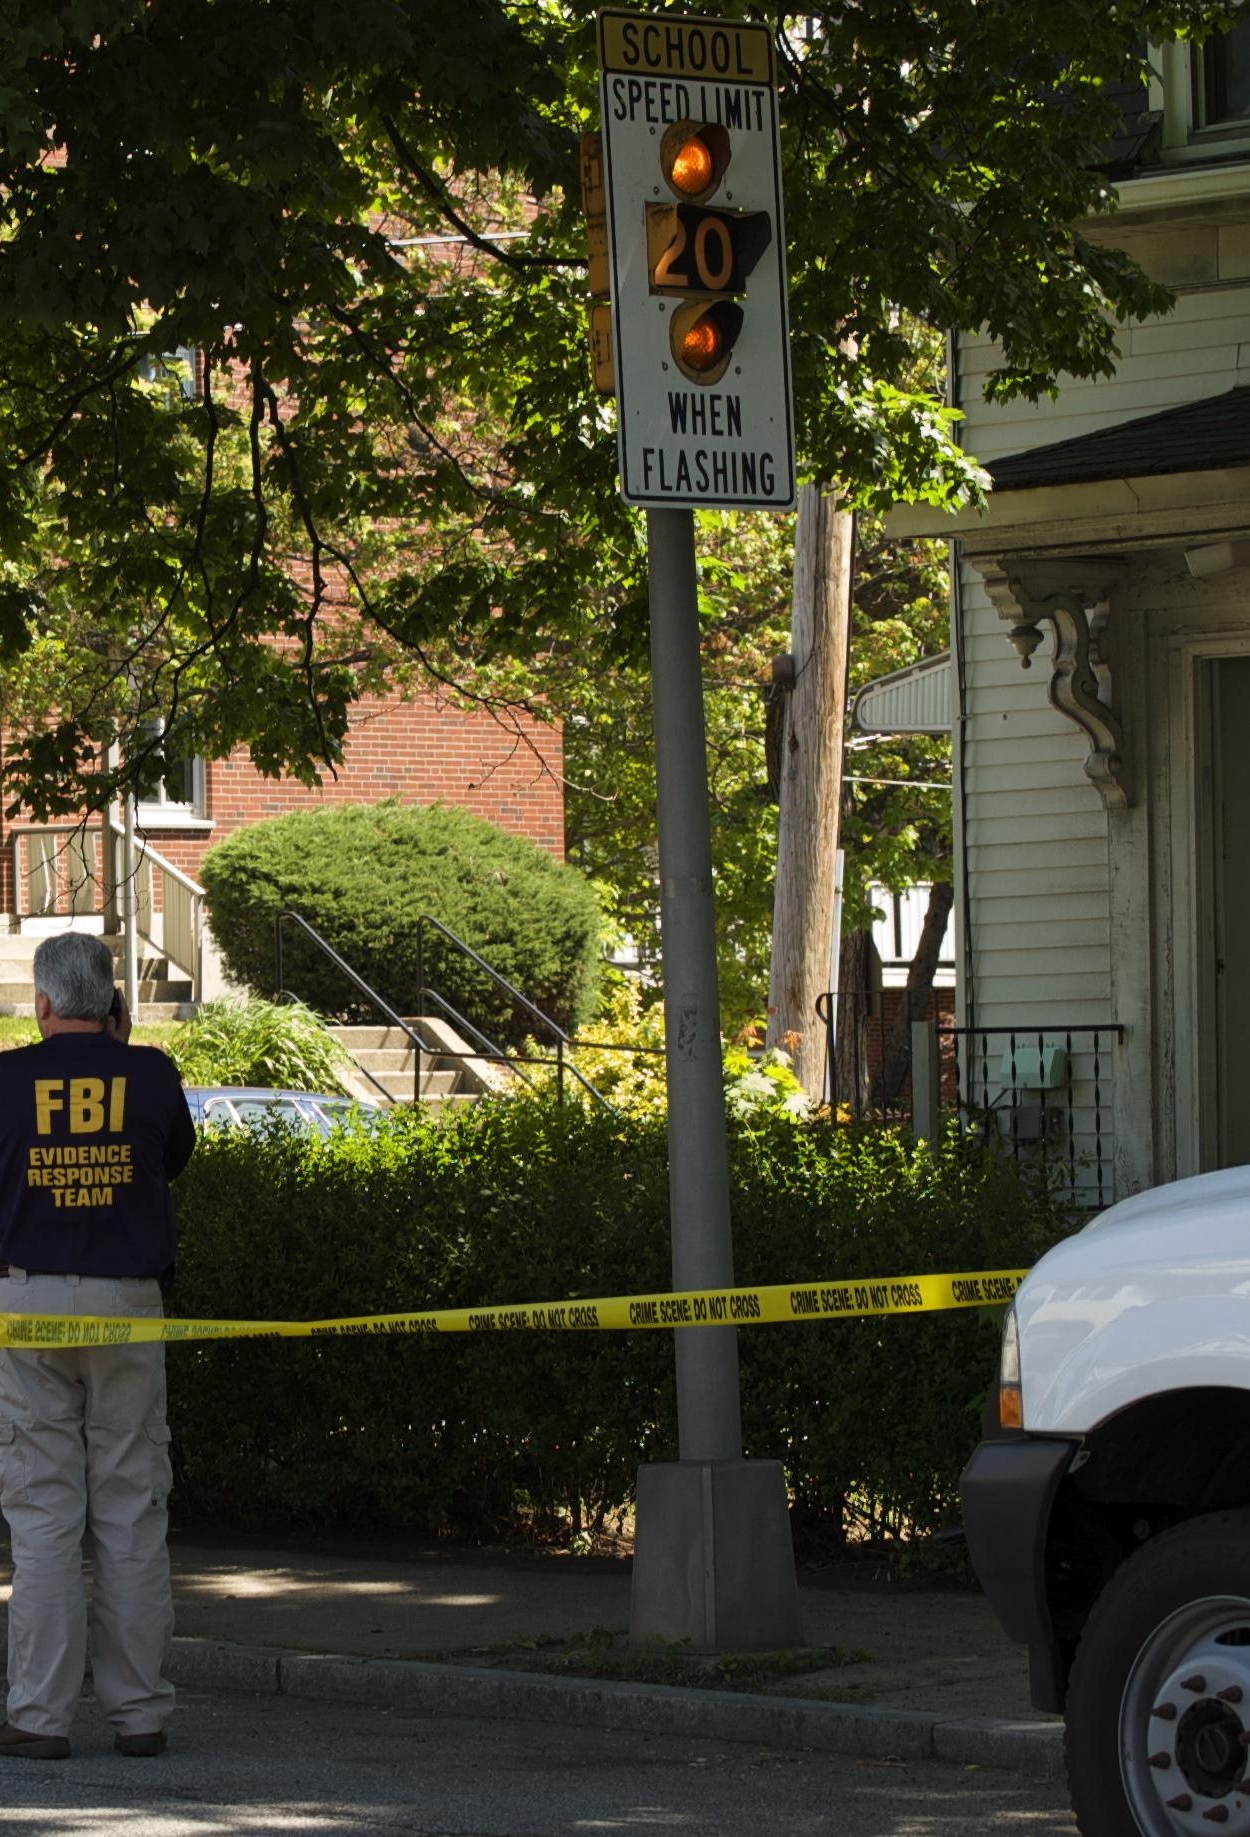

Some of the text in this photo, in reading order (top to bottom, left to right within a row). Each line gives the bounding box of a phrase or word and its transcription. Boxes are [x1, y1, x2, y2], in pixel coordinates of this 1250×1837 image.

[622, 22, 753, 75] SCHOOL
[613, 79, 764, 132] SPEED LIMIT
[654, 216, 733, 290] 20
[667, 392, 742, 437] WHEN
[642, 448, 775, 496] FLASHING
[35, 1076, 126, 1135] FBI
[29, 1144, 131, 1166] EVIDENCE
[27, 1166, 133, 1187] RESPONSE
[51, 1187, 113, 1208] TEAM
[790, 1283, 923, 1314] CRIME SCENE: DO NOT CROSS
[952, 1280, 982, 1302] CRIME
[468, 1306, 599, 1330] CRIME SCENE: DO NOT CROSS
[629, 1294, 761, 1325] CRIME SCENE: DO NOT CROSS
